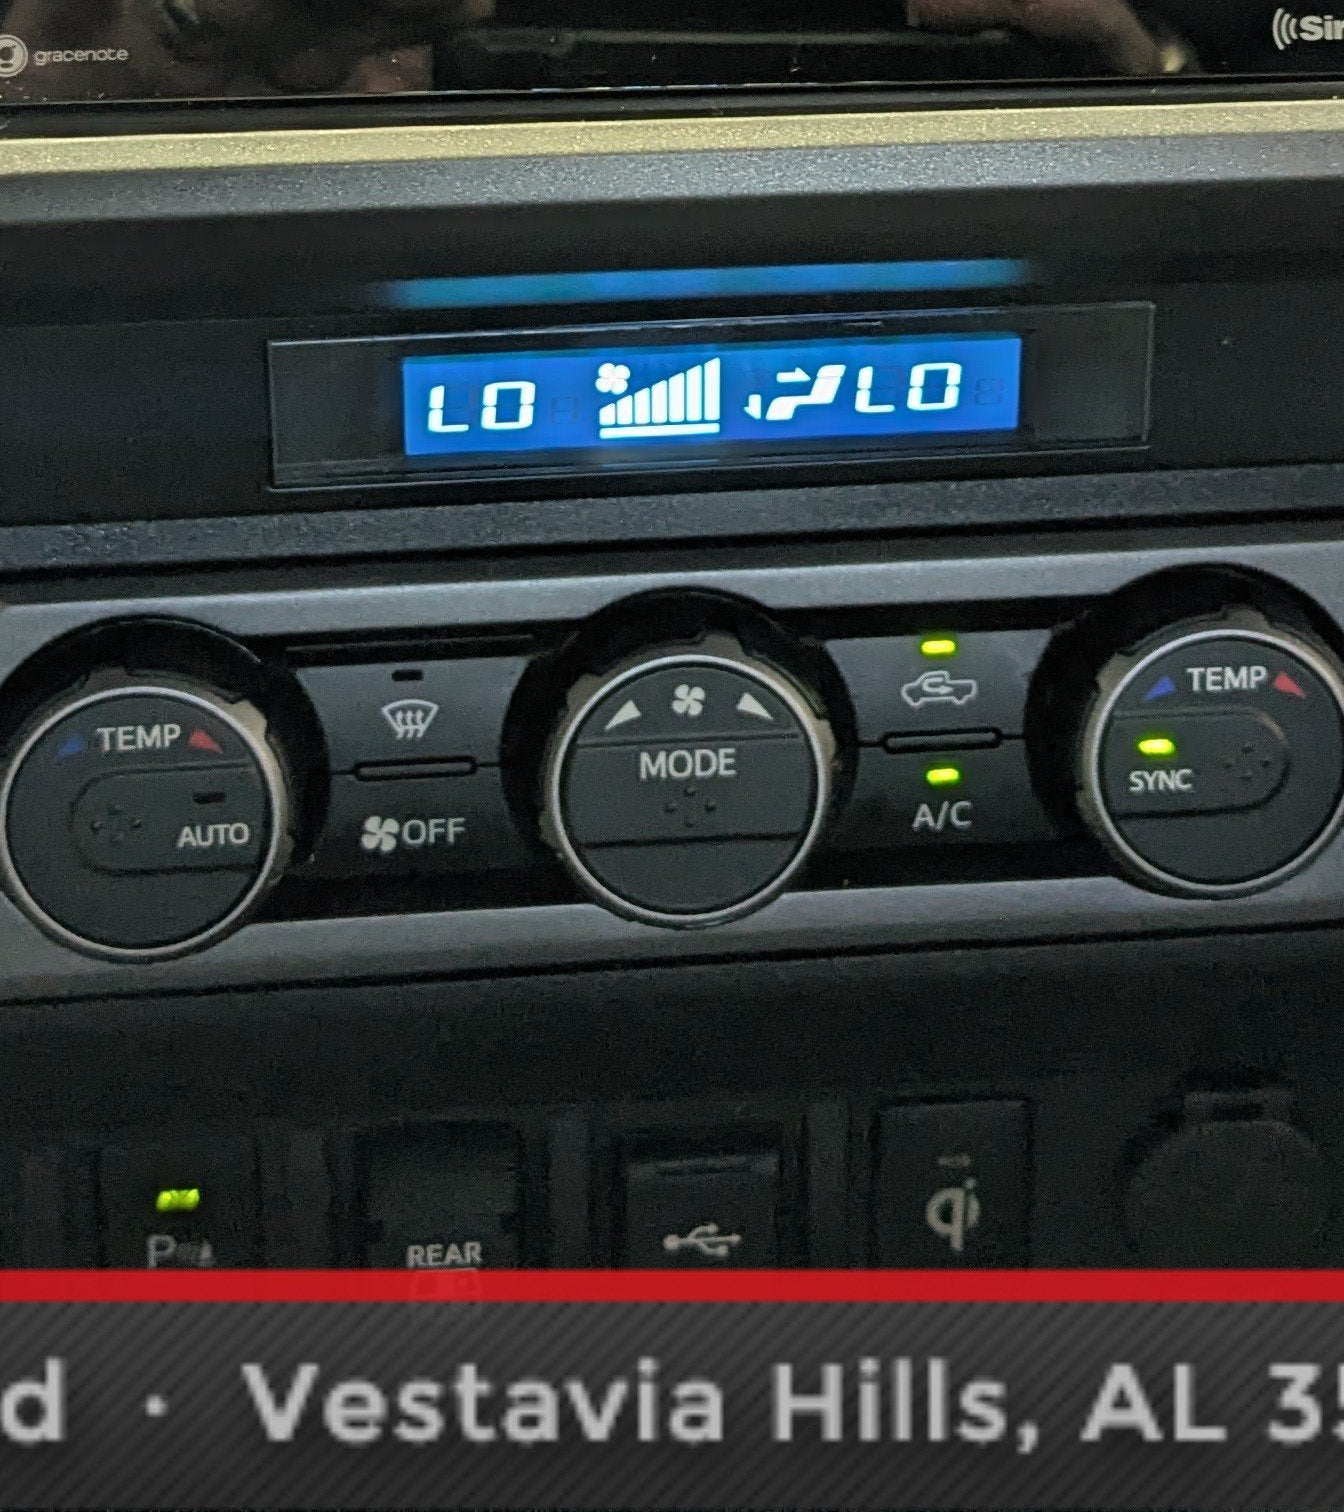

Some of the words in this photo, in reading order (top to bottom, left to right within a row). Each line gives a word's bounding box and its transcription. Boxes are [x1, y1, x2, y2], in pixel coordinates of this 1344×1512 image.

[34, 49, 129, 66] gracenote
[1186, 665, 1268, 692] TEMP
[96, 723, 181, 752] TEMP
[639, 747, 736, 780] MODE
[1129, 768, 1192, 793] SYNC
[912, 800, 972, 830] A/C
[177, 822, 250, 848] AUTO
[401, 817, 465, 846] OFF
[407, 1242, 482, 1268] REAR
